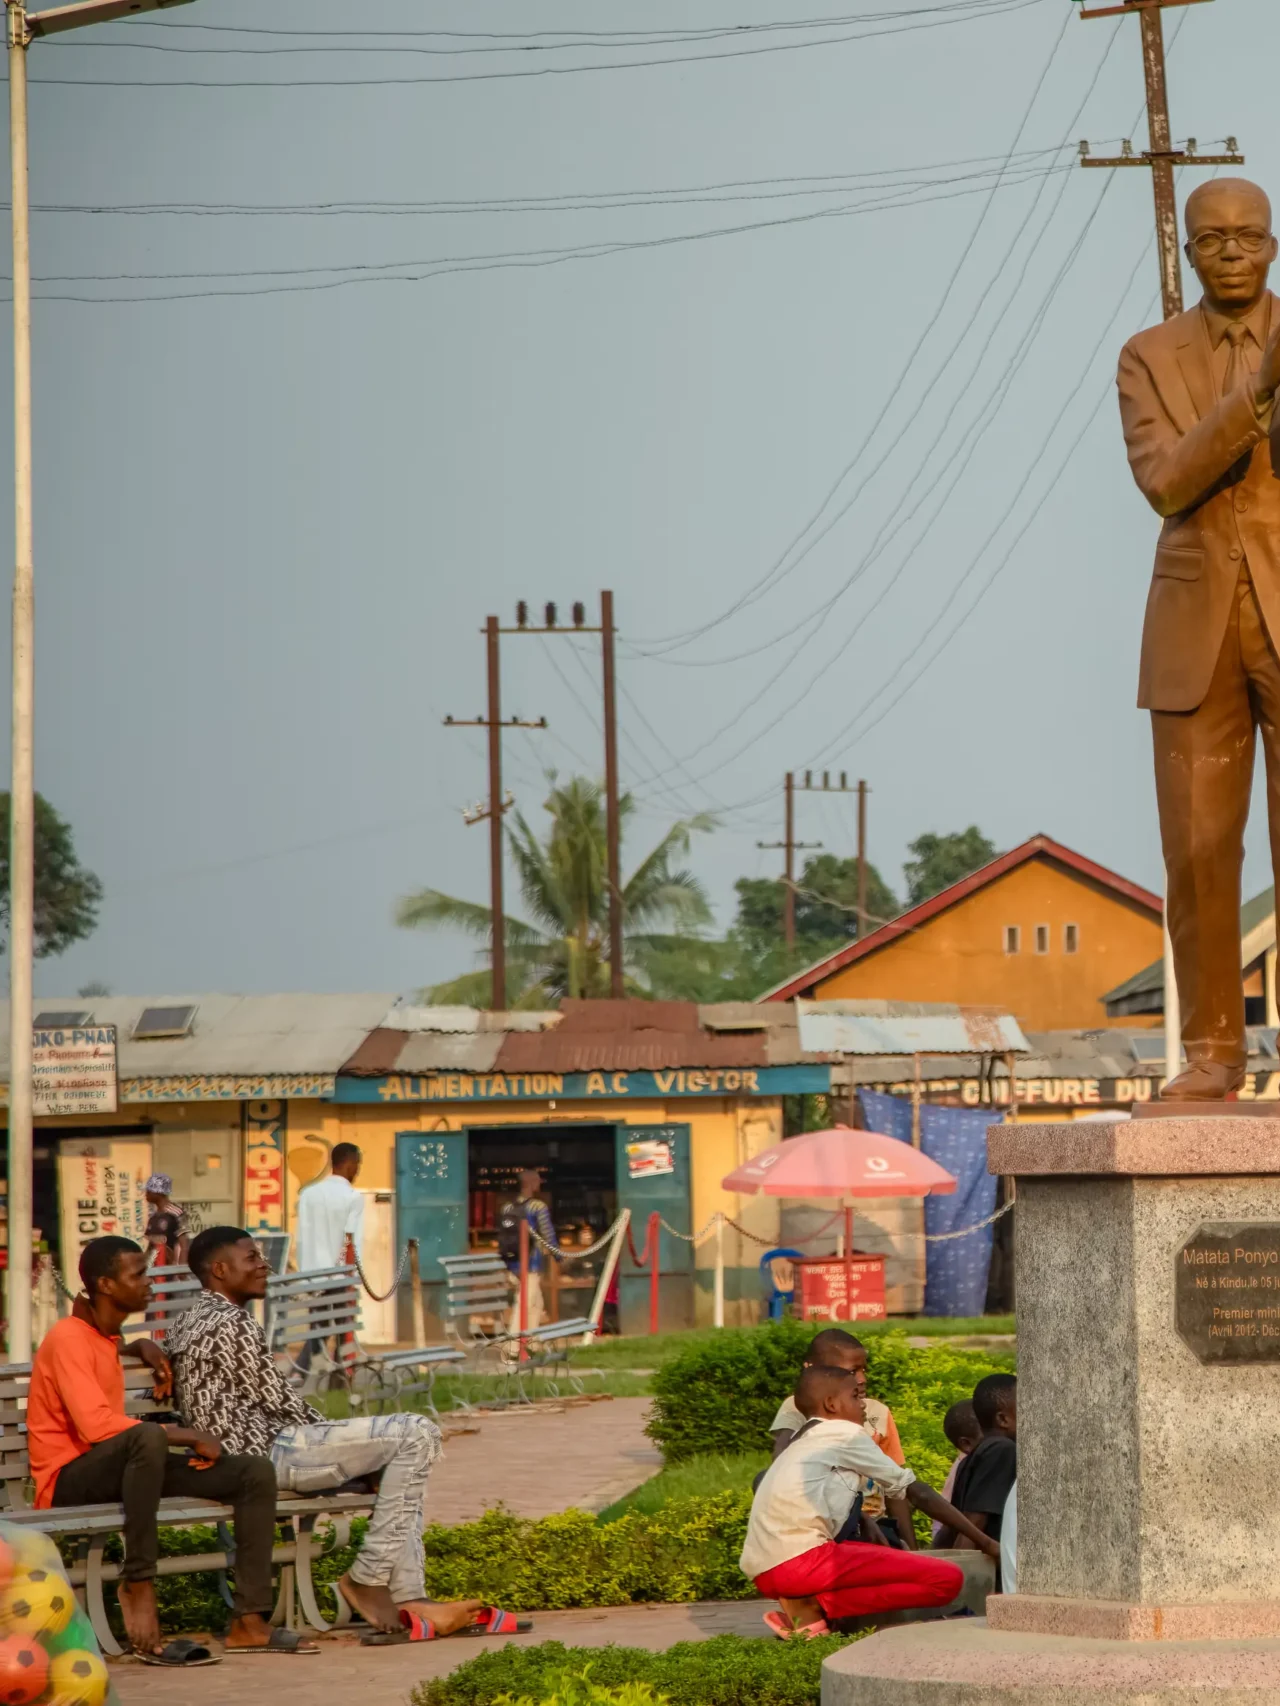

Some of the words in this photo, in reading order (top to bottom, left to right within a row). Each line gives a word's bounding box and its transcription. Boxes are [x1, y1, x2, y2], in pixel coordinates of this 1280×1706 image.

[378, 1074, 563, 1100] ALIMENTATION
[586, 1073, 629, 1095] A.C
[1115, 1078, 1151, 1102] DU
[1183, 1249, 1230, 1265] Matata
[1234, 1248, 1279, 1268] Ponyo
[1196, 1276, 1209, 1289] Né
[1211, 1277, 1217, 1289] à
[1260, 1276, 1272, 1288] 05
[1213, 1307, 1255, 1320] Premier
